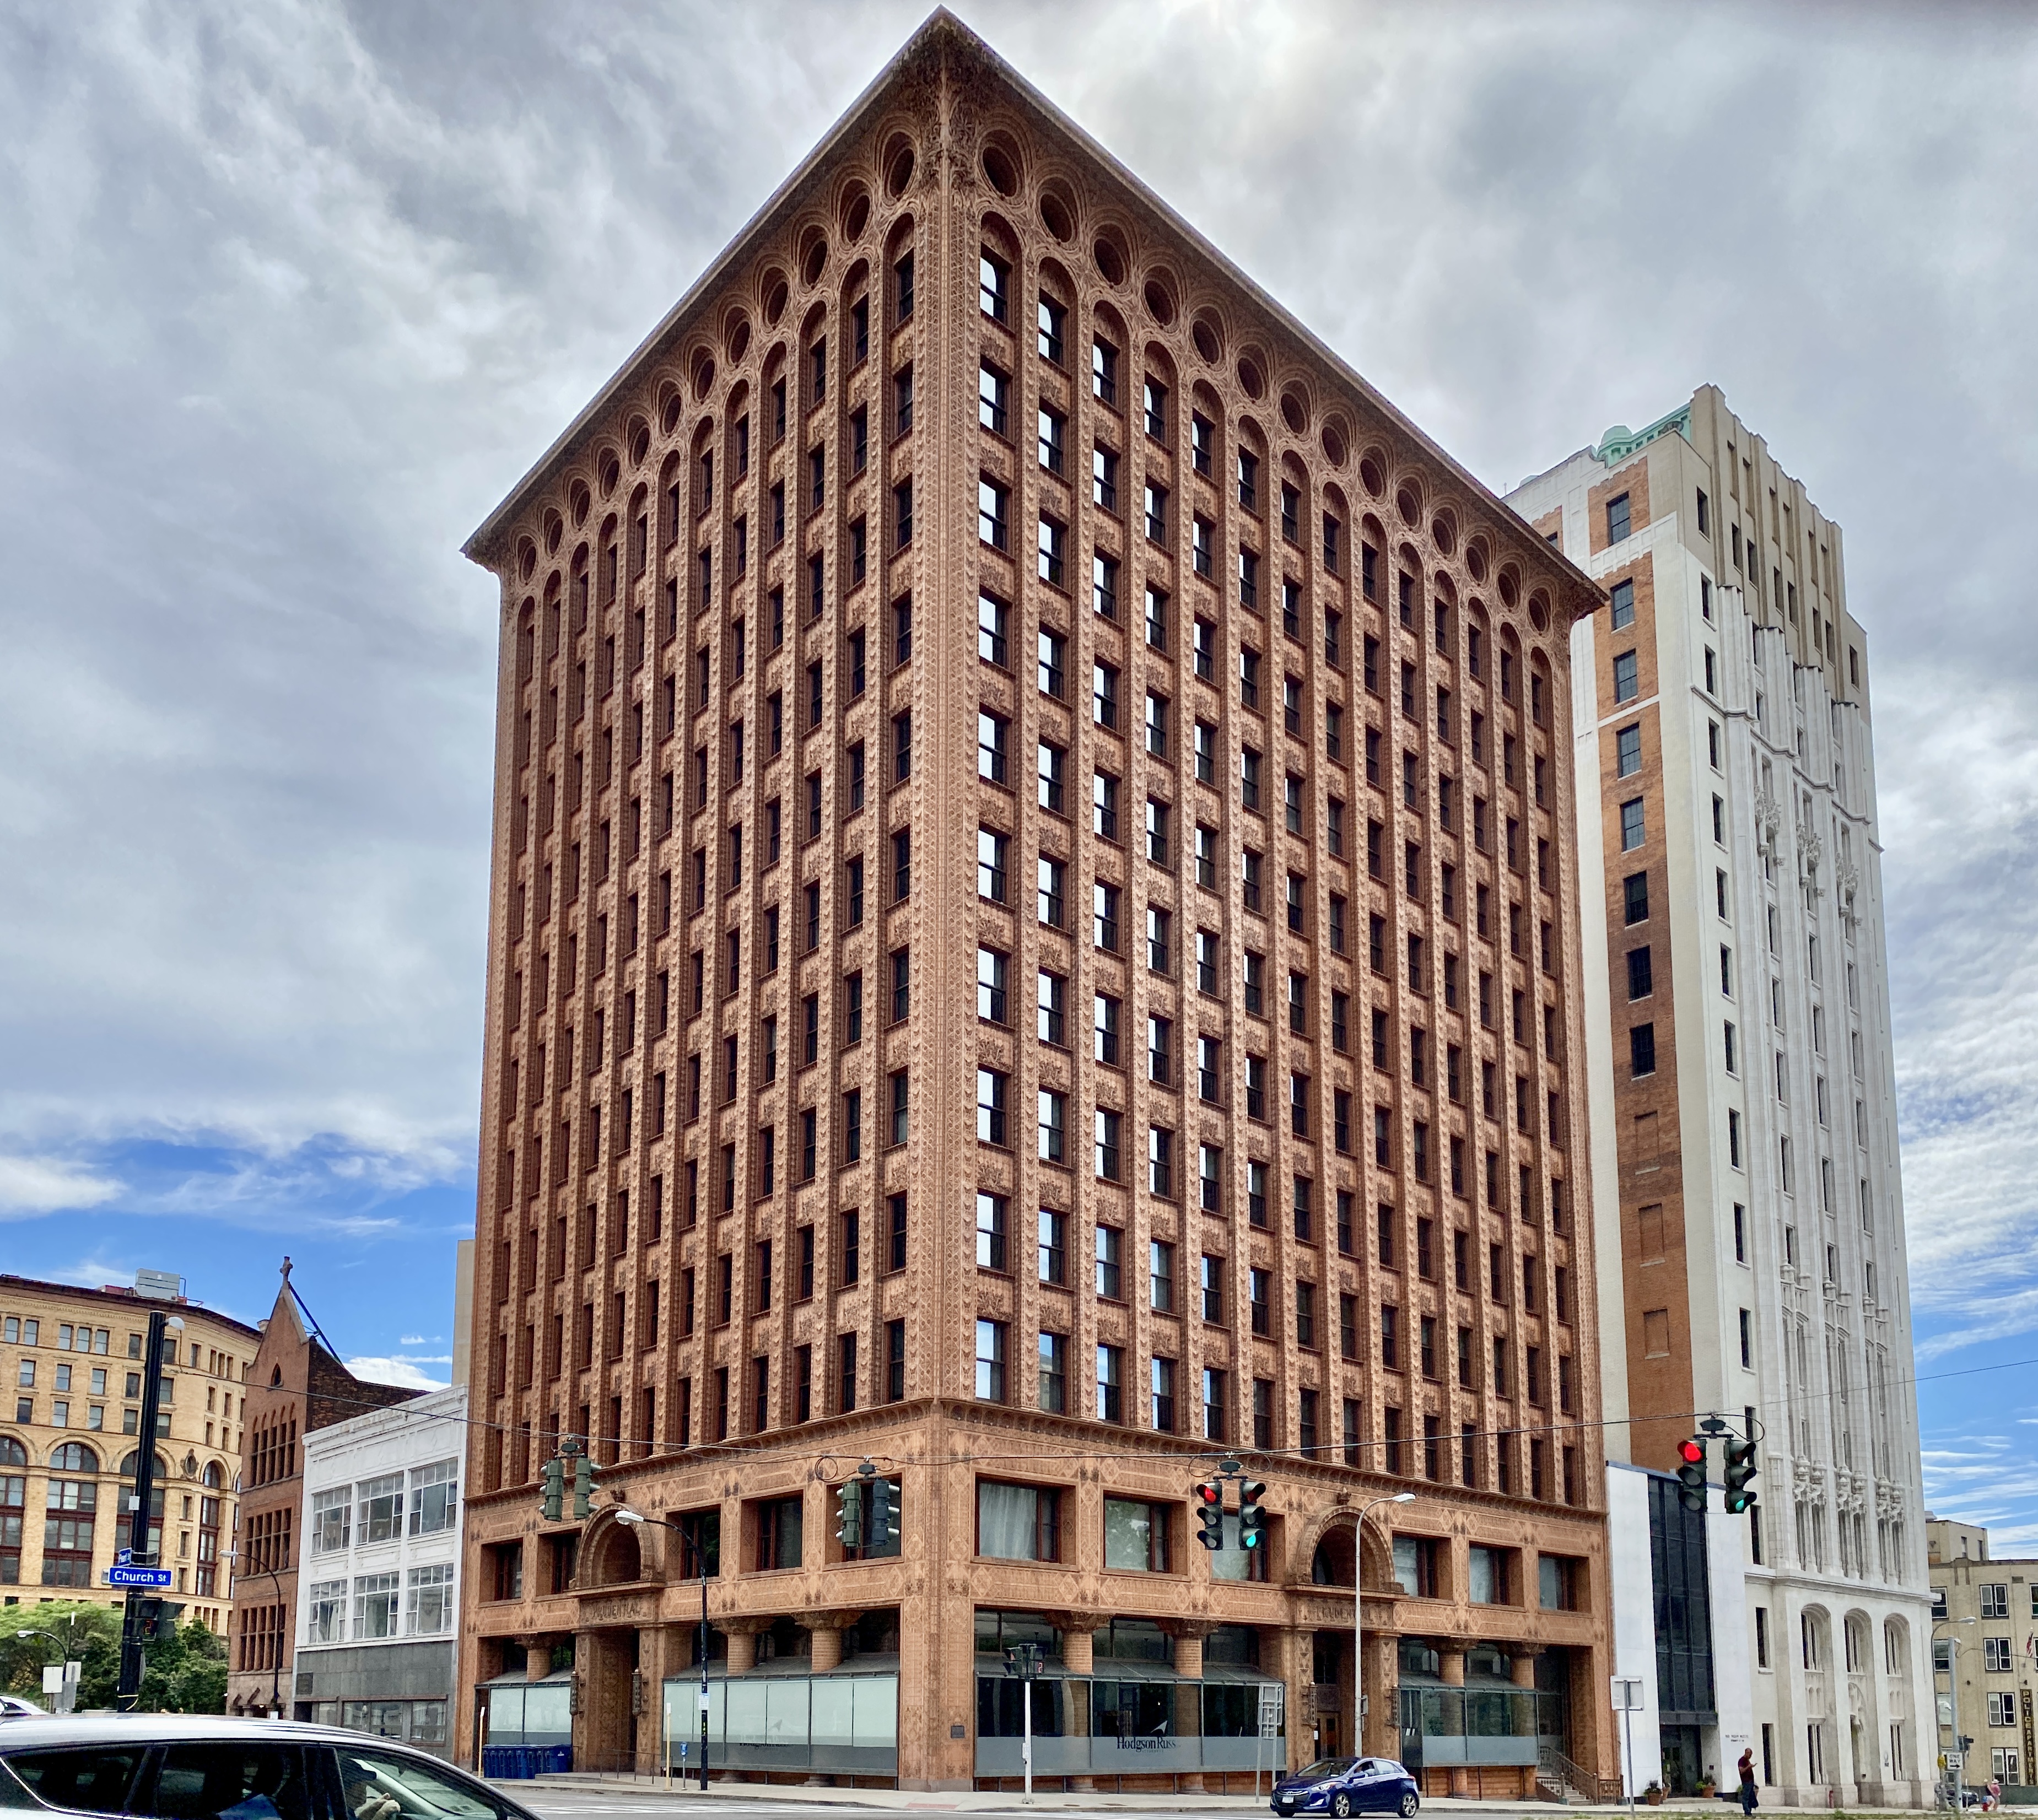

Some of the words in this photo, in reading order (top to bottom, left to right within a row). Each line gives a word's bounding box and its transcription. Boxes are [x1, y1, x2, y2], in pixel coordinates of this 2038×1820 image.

[114, 1570, 154, 1583] Church
[592, 1602, 640, 1619] PRUDENTIAL
[1316, 1603, 1374, 1621] PRUDENTAL
[1038, 1662, 1043, 1673] 2
[2023, 1691, 2032, 1729] POLICE
[1117, 1736, 1156, 1753] Hodgson
[1157, 1736, 1176, 1749] Russ
